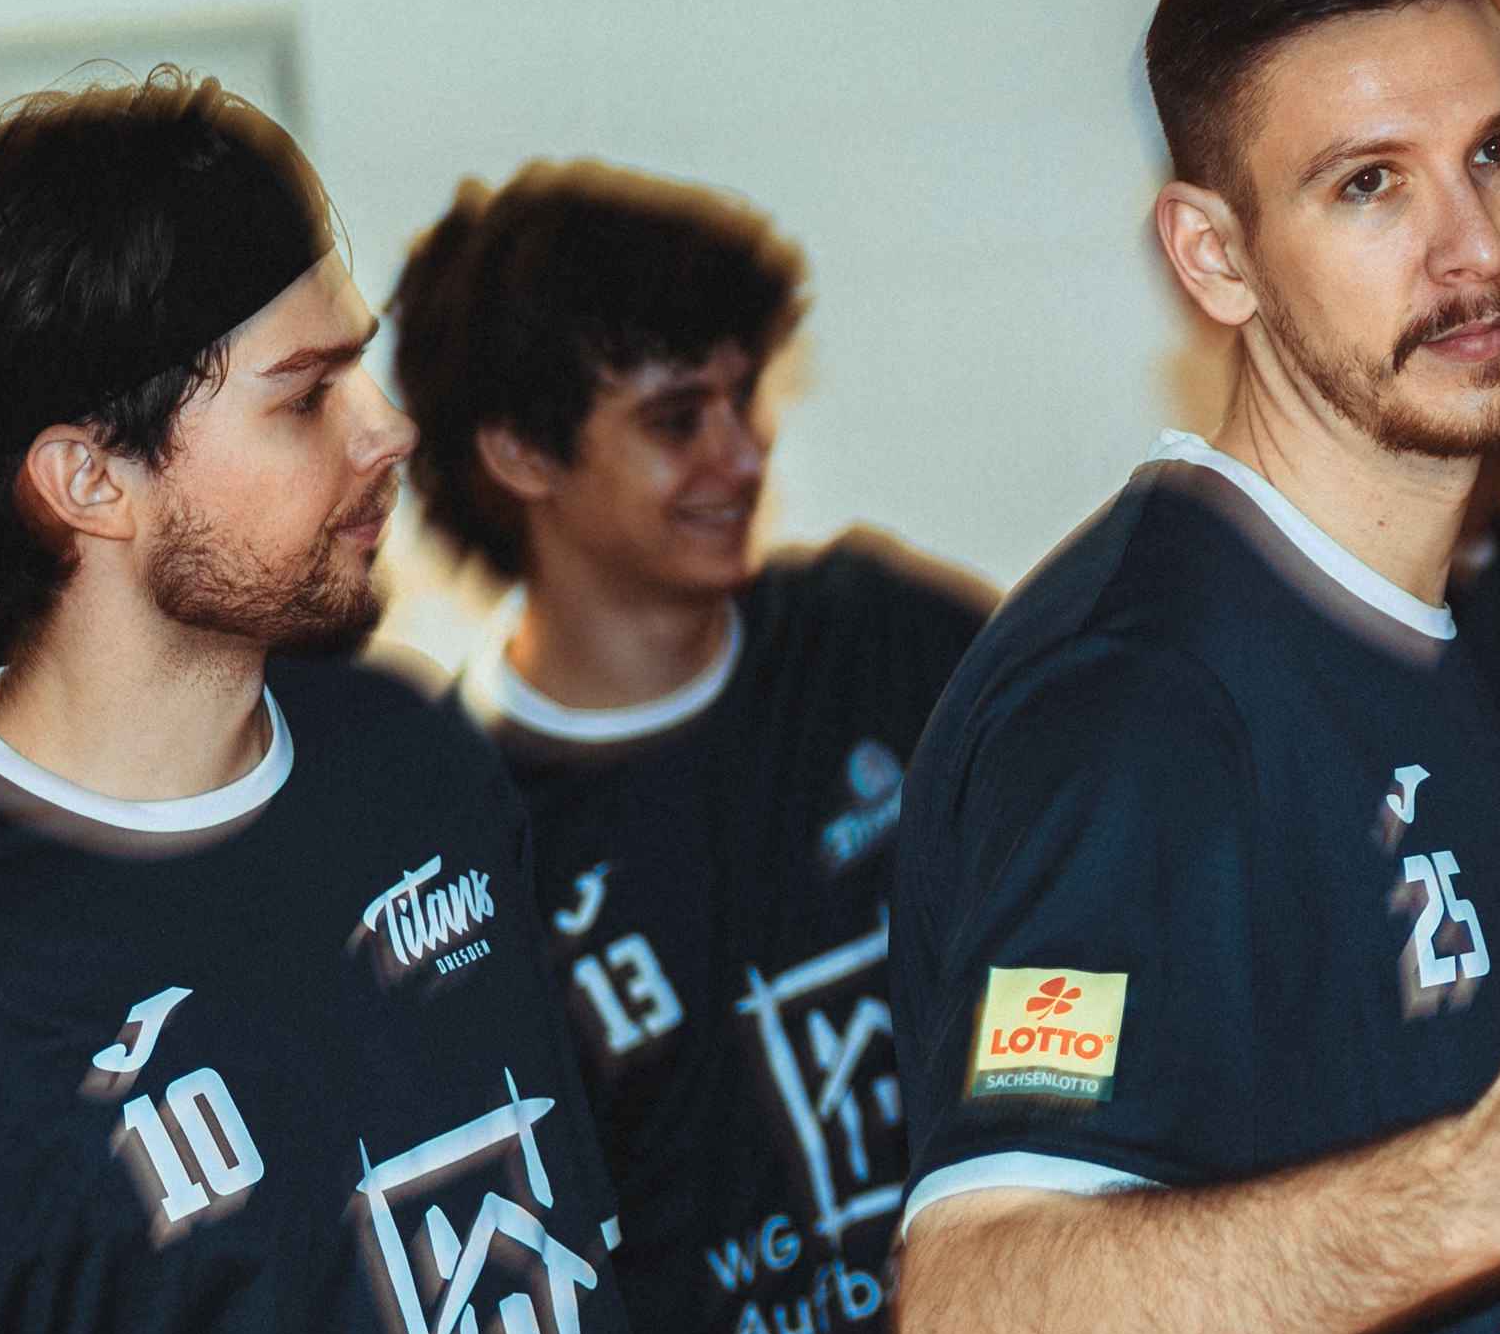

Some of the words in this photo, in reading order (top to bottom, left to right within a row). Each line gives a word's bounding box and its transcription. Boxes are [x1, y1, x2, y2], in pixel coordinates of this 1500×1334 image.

[363, 854, 495, 965] Titans
[435, 938, 491, 975] DRESDEN
[1404, 850, 1490, 988] 25
[573, 933, 683, 1054] 13
[985, 1071, 1099, 1093] SACHSENLOTTO
[123, 1067, 264, 1223] 10
[706, 1214, 801, 1292] WG
